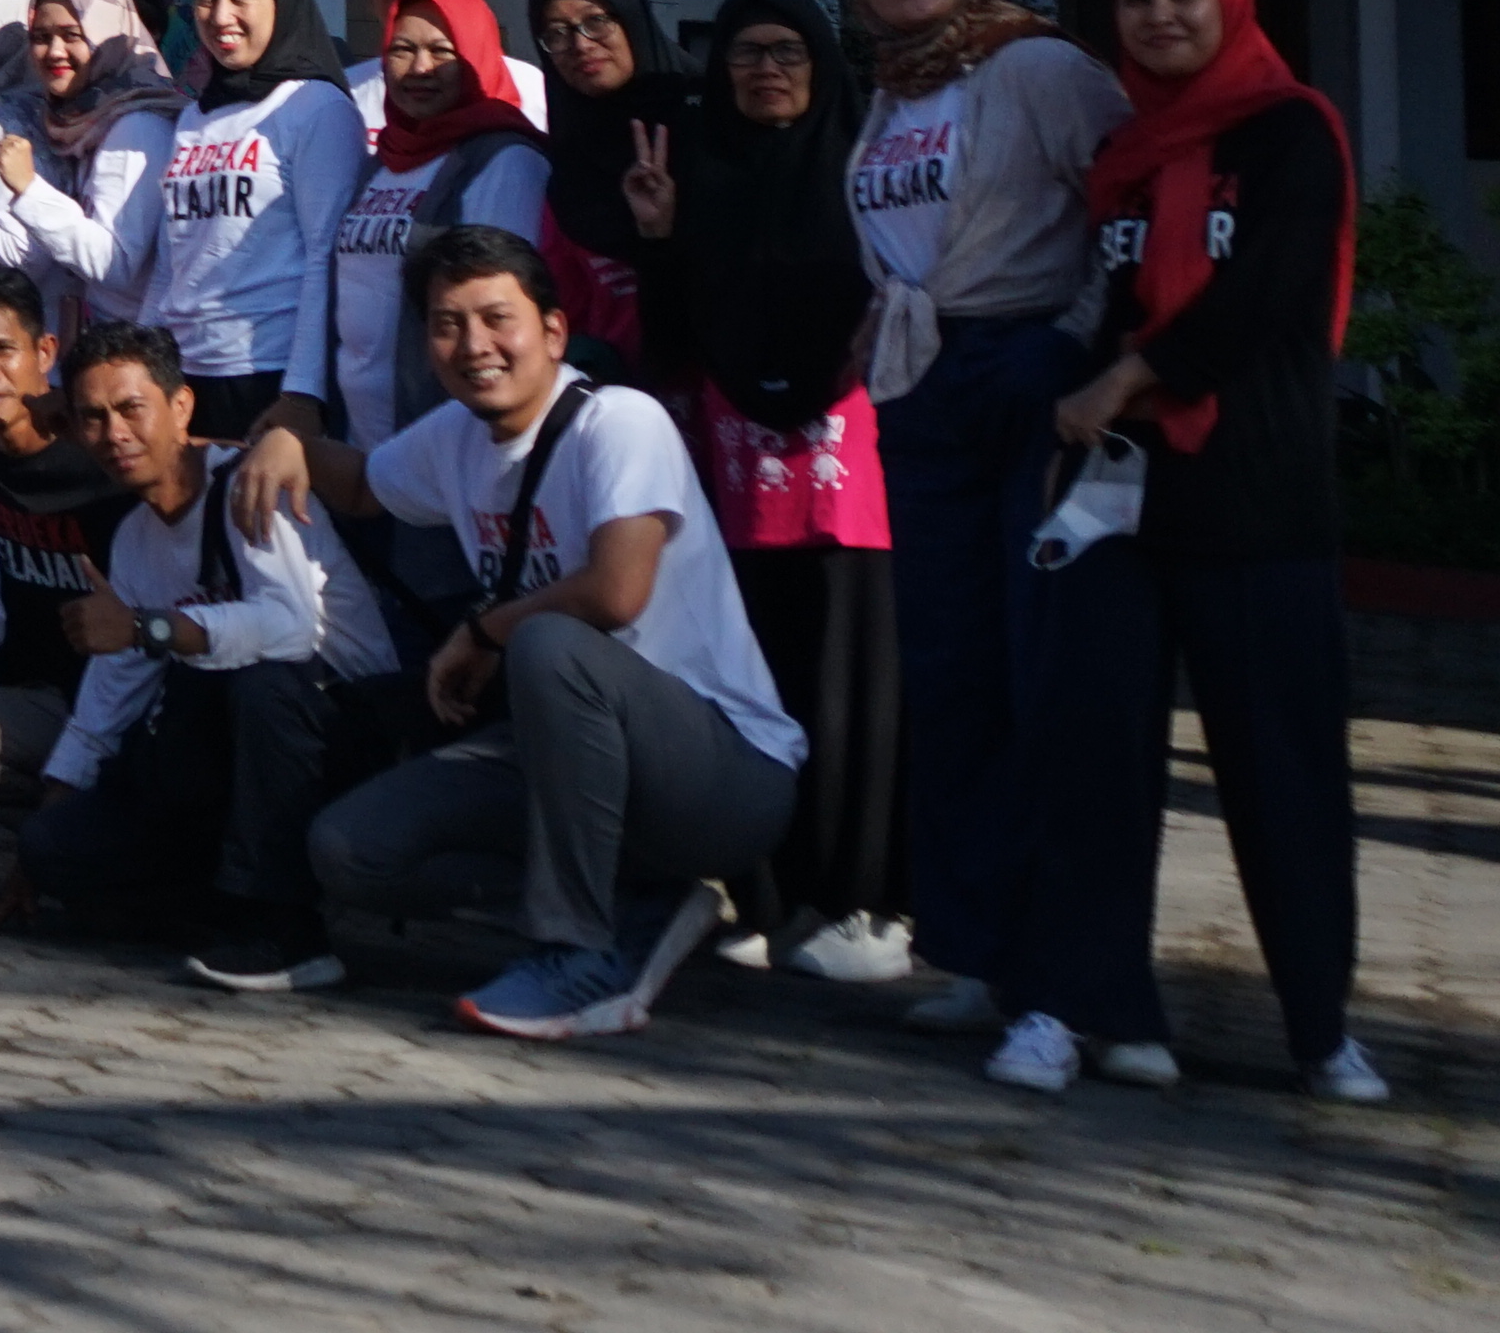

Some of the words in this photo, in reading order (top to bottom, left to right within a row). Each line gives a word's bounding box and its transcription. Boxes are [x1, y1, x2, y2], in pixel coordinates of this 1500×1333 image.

[167, 138, 261, 179] ERDEKA
[164, 175, 255, 221] ELAJAR
[853, 157, 950, 214] ELAJAR
